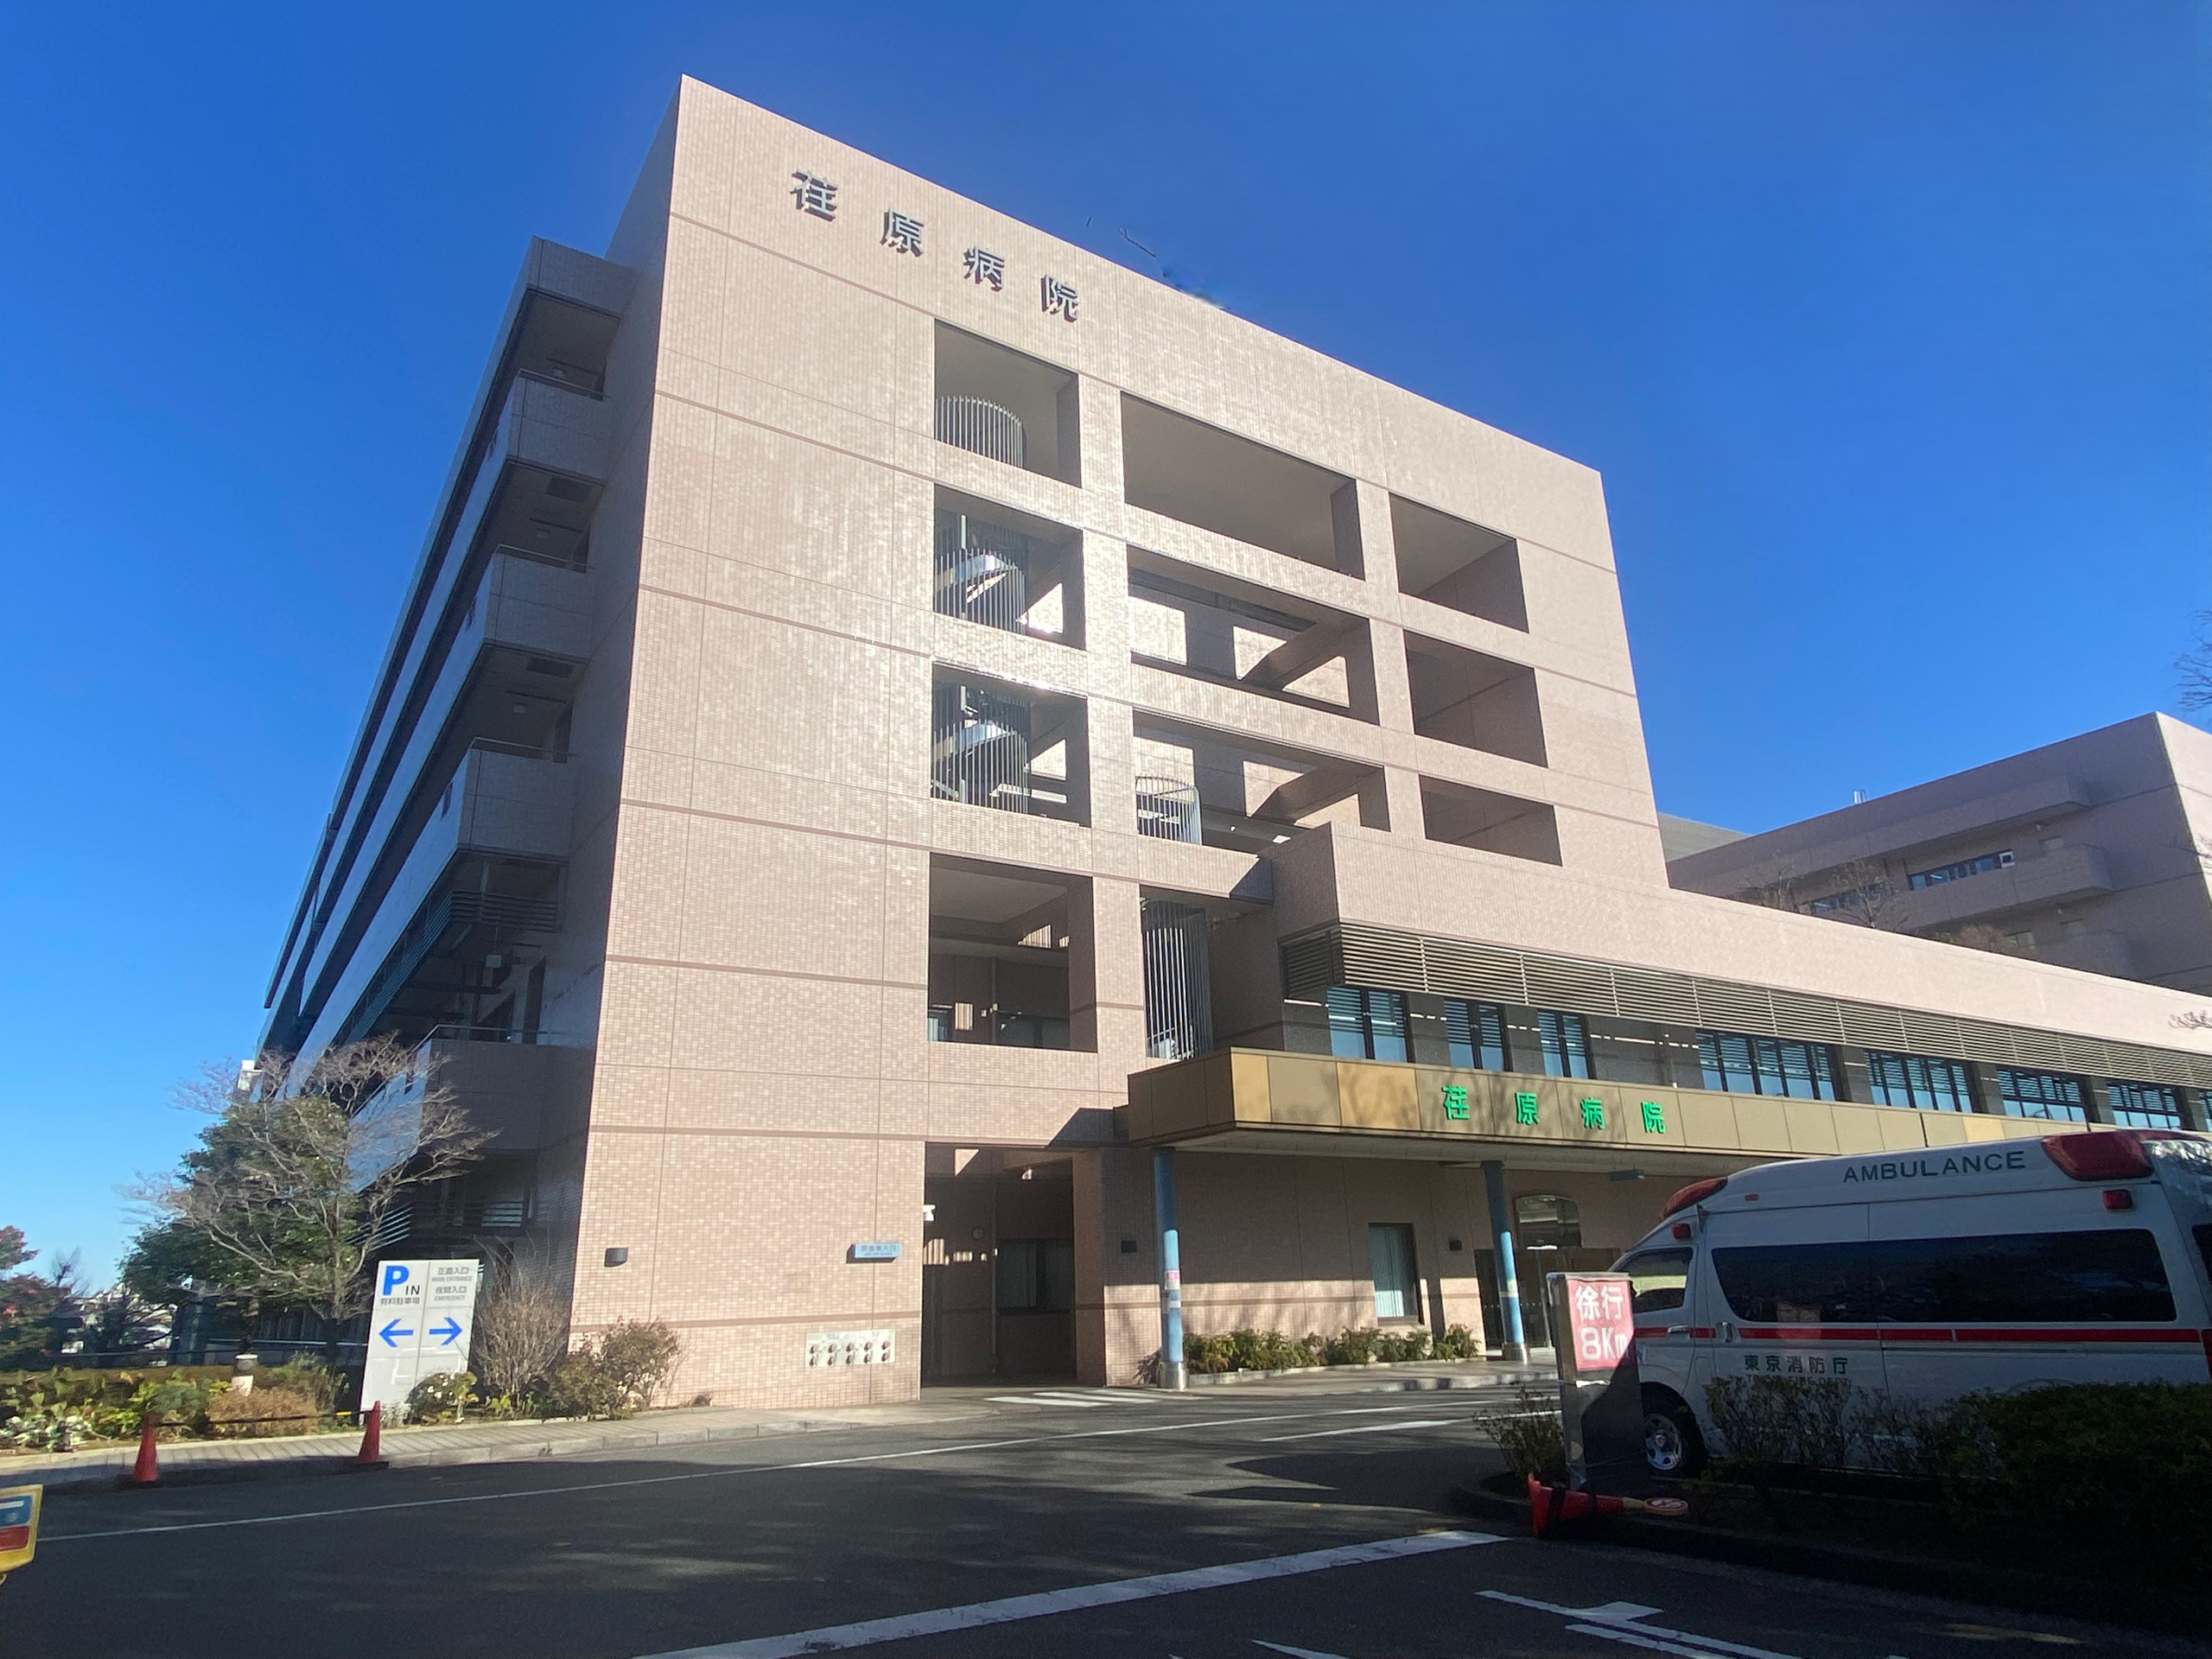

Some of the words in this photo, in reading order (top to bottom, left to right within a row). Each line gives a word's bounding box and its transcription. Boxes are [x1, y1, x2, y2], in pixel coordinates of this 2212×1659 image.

[790, 169, 1079, 321] 荏原病院
[1441, 1084, 1667, 1135] 荏原病院
[1843, 1151, 2026, 1183] AMBULANCE
[383, 1265, 410, 1295] P
[405, 1285, 420, 1295] IN
[1575, 1285, 1624, 1322] 徐行
[1744, 1354, 1848, 1375] 東京消防庁
